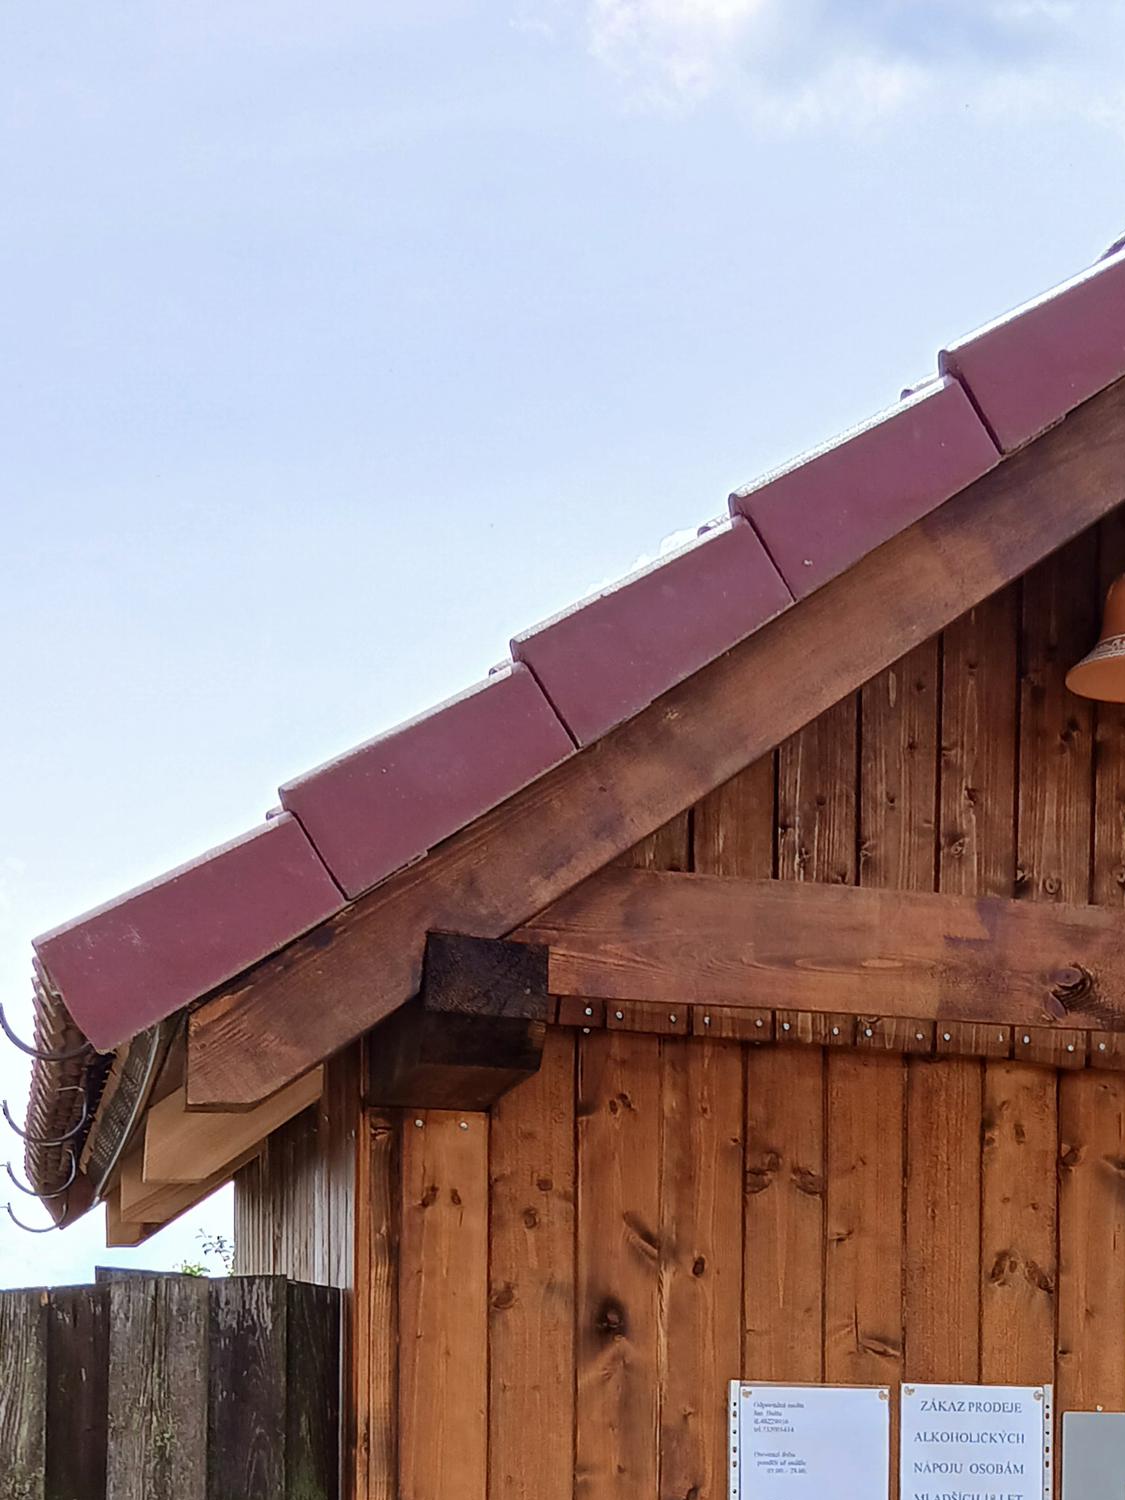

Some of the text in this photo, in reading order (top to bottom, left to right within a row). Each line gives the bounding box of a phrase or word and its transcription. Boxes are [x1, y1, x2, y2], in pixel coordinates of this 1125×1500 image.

[920, 1397, 1022, 1413] ZÁKAZ PRODEJE
[913, 1430, 1025, 1444] ALKOHOLICKÝCH
[969, 1460, 1024, 1475] OSOBÁM
